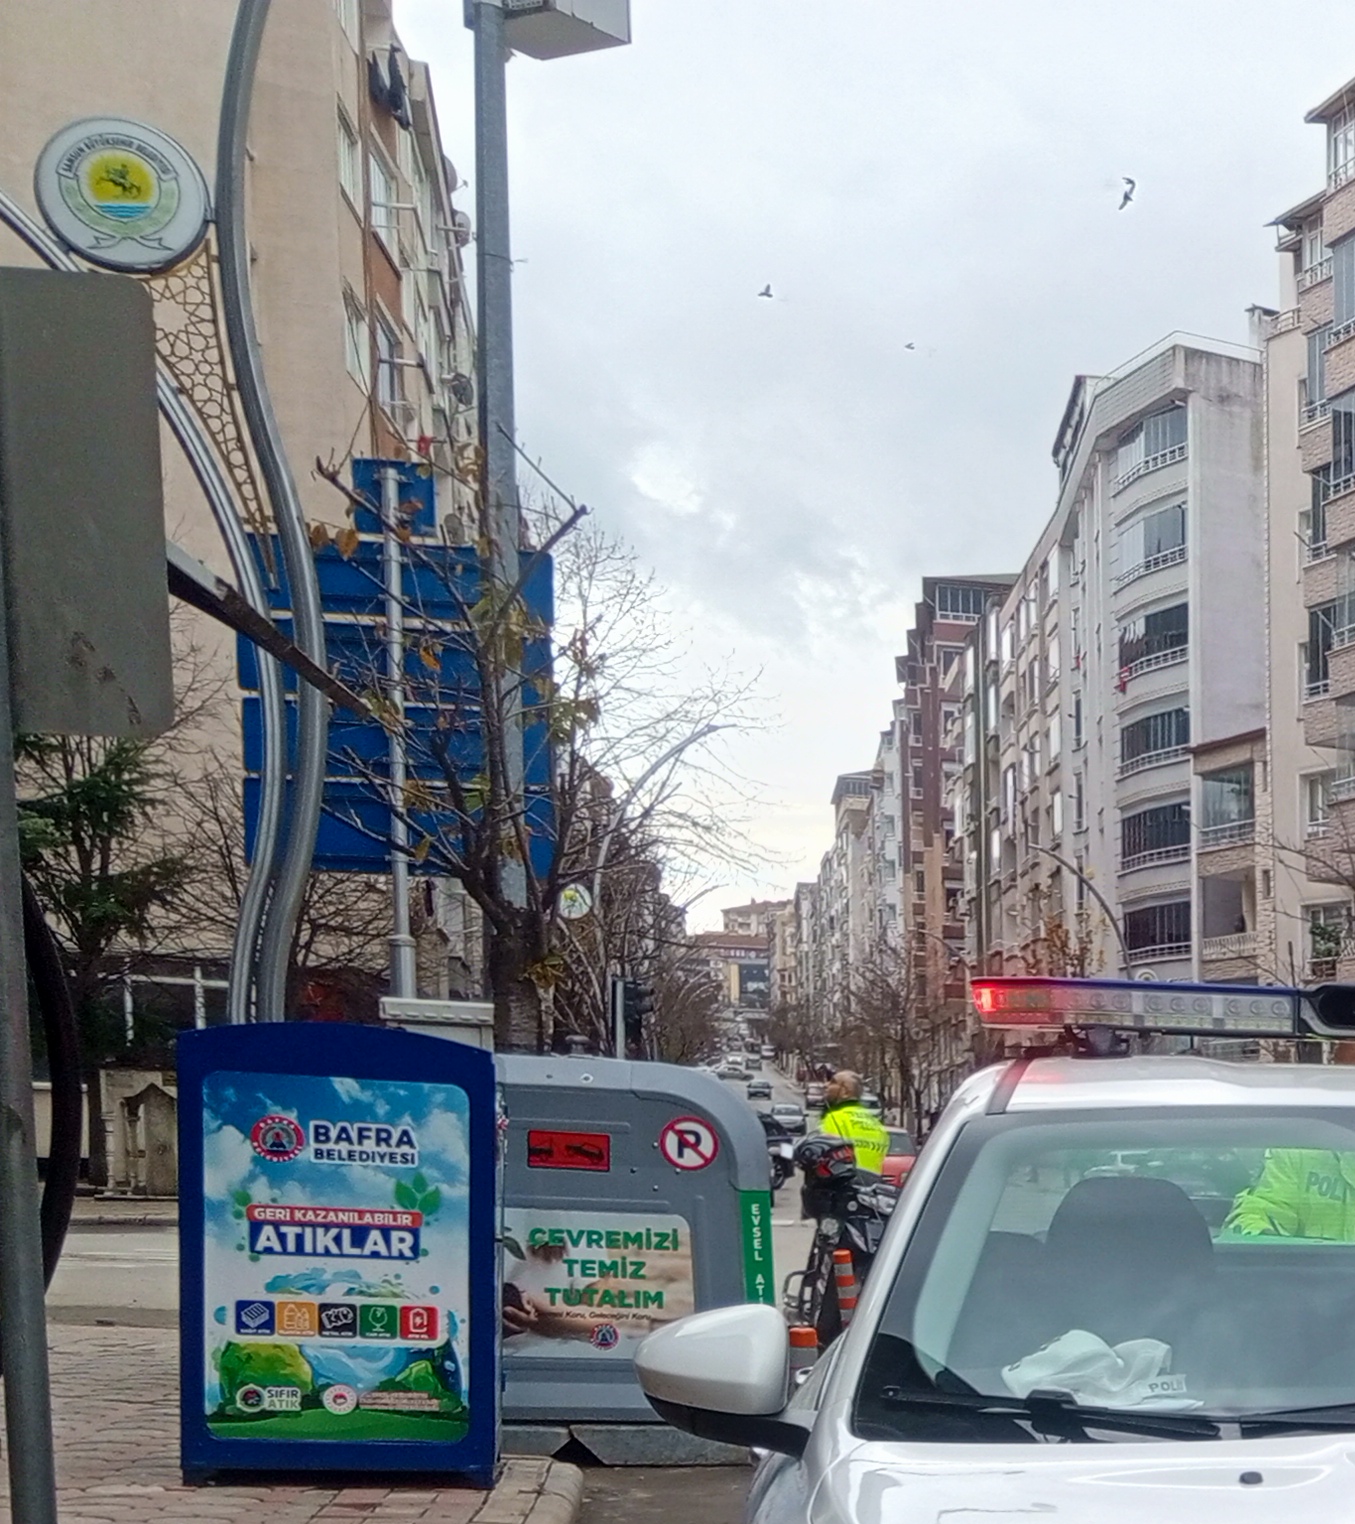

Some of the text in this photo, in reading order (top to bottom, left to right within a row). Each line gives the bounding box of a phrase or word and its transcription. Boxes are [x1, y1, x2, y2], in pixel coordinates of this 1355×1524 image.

[313, 1124, 417, 1150] BAFRA
[314, 1148, 416, 1165] BELEDİYESİ
[254, 1207, 413, 1226] GERİ KAZANILABİLİR
[254, 1225, 415, 1257] ATIKLAR
[528, 1226, 679, 1251] ÇEVREMİZİ
[750, 1203, 764, 1261] EVSEL
[562, 1256, 647, 1279] TEMİZ
[544, 1287, 664, 1309] TUTALIM
[266, 1389, 299, 1399] SIFIR
[267, 1399, 299, 1410] ATIK
